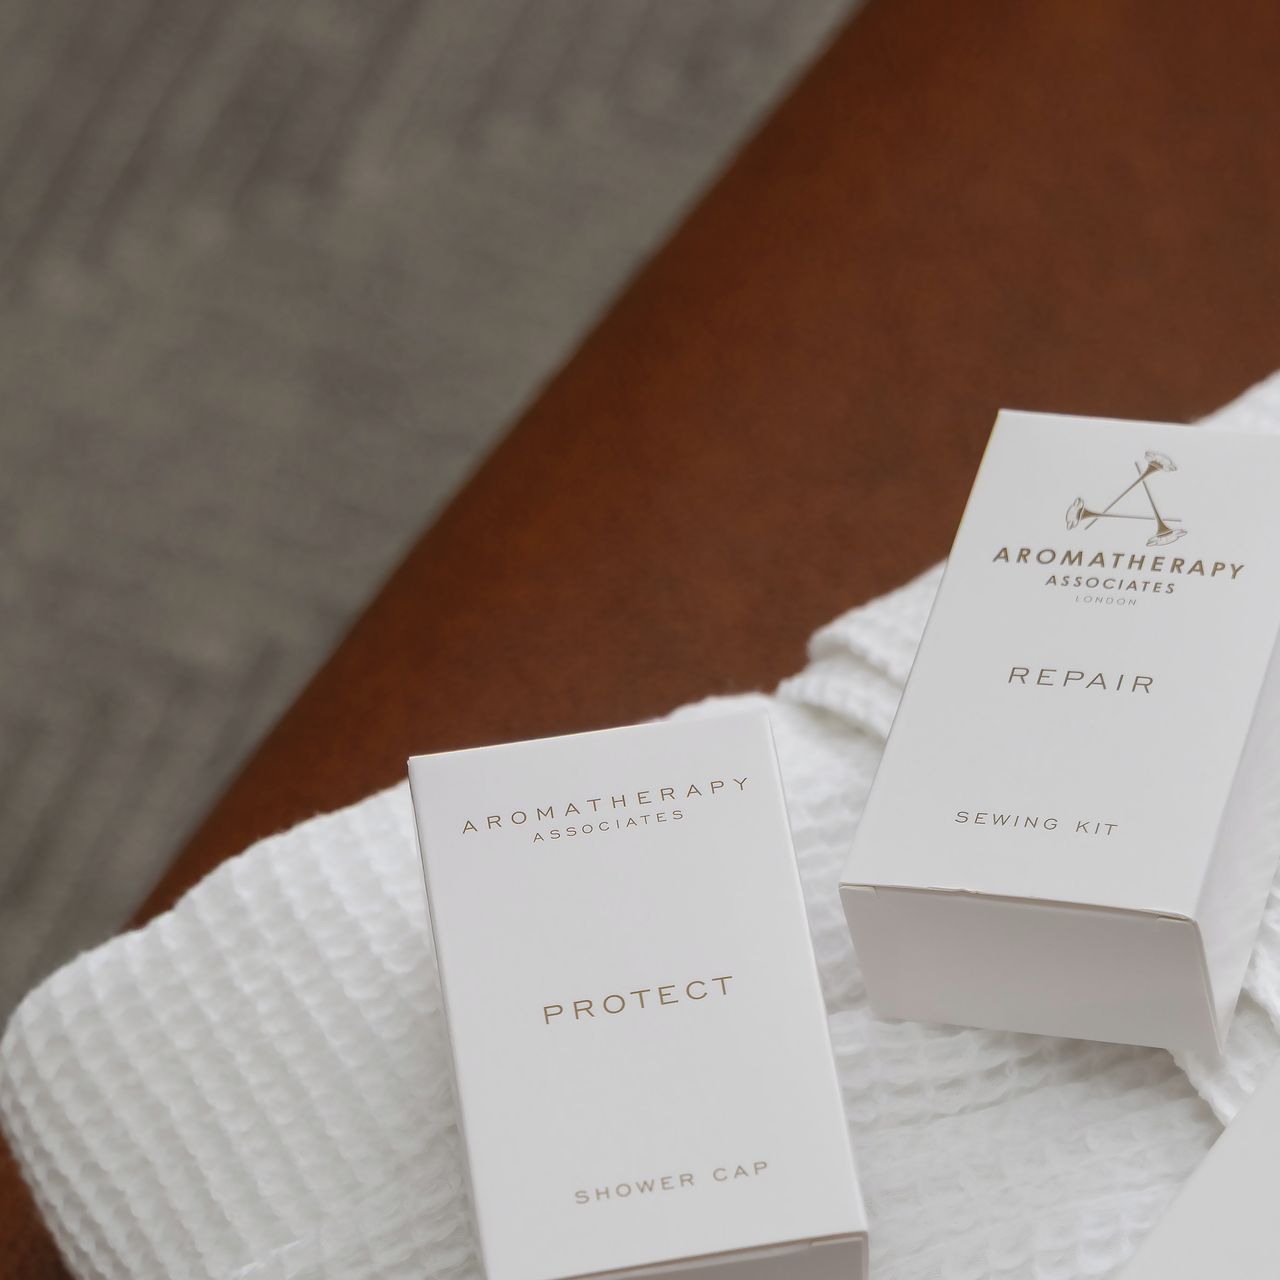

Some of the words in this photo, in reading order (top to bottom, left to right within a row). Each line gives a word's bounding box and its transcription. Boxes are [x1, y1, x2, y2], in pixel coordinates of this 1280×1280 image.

[992, 546, 1245, 580] AROMATHERAPY
[1045, 574, 1176, 595] ASSOCIATES
[1074, 594, 1137, 606] LONDON
[1007, 666, 1154, 694] REPAIR
[462, 777, 749, 834] AROMATHERAPY
[532, 809, 684, 843] ASSOCIATES
[955, 810, 1058, 831] SEWING
[1075, 820, 1118, 836] KIT
[543, 975, 733, 1025] PROTECT
[574, 1172, 695, 1205] SHOWER
[712, 1160, 769, 1182] CAP
